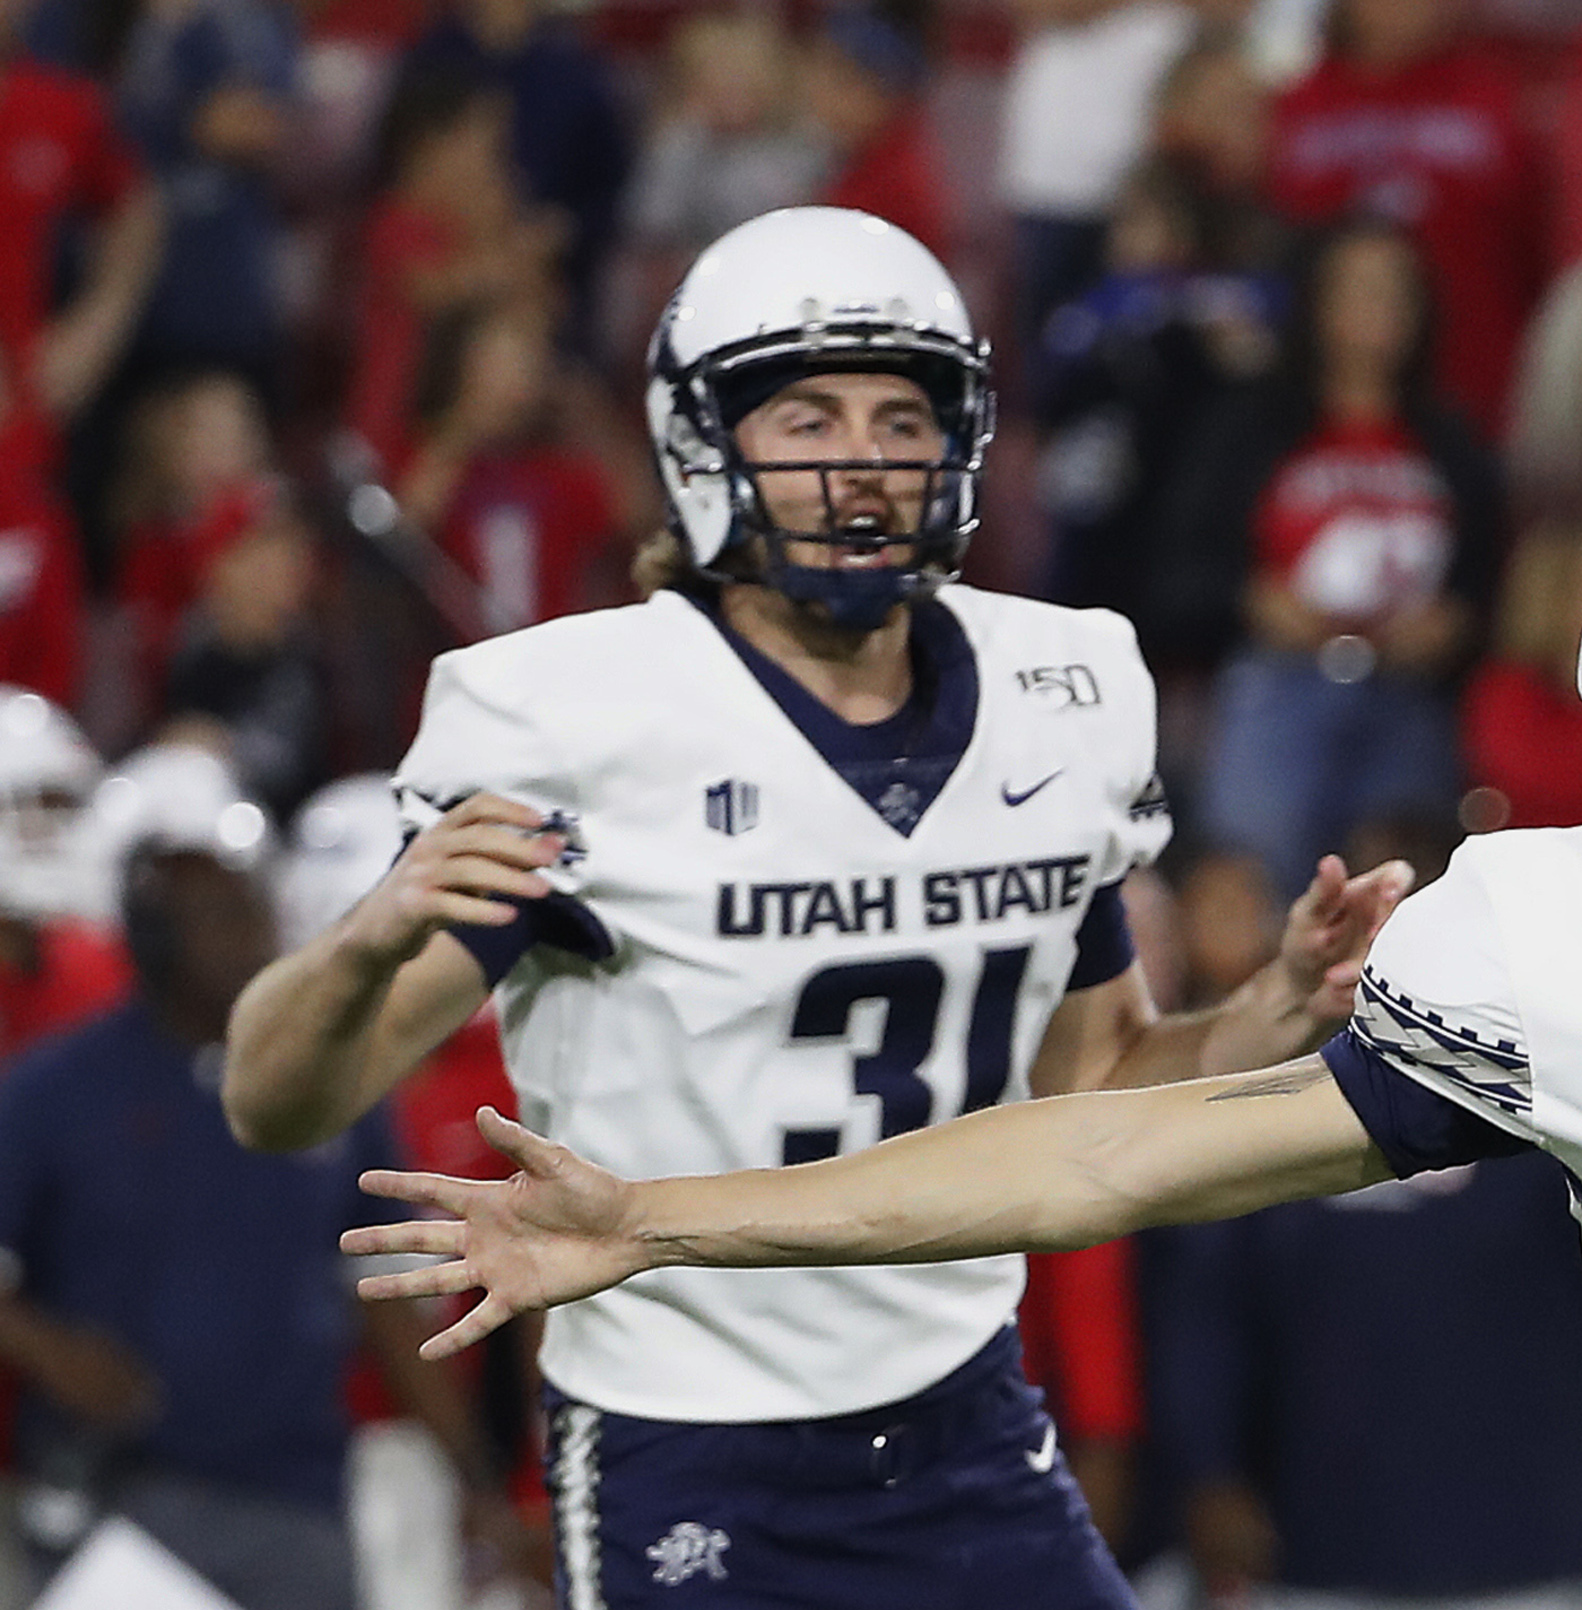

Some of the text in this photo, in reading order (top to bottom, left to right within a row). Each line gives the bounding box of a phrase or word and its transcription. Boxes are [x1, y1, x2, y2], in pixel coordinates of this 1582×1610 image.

[1015, 663, 1101, 707] 150
[715, 855, 1093, 938] UTAH STATE
[779, 944, 1037, 1169] 31
